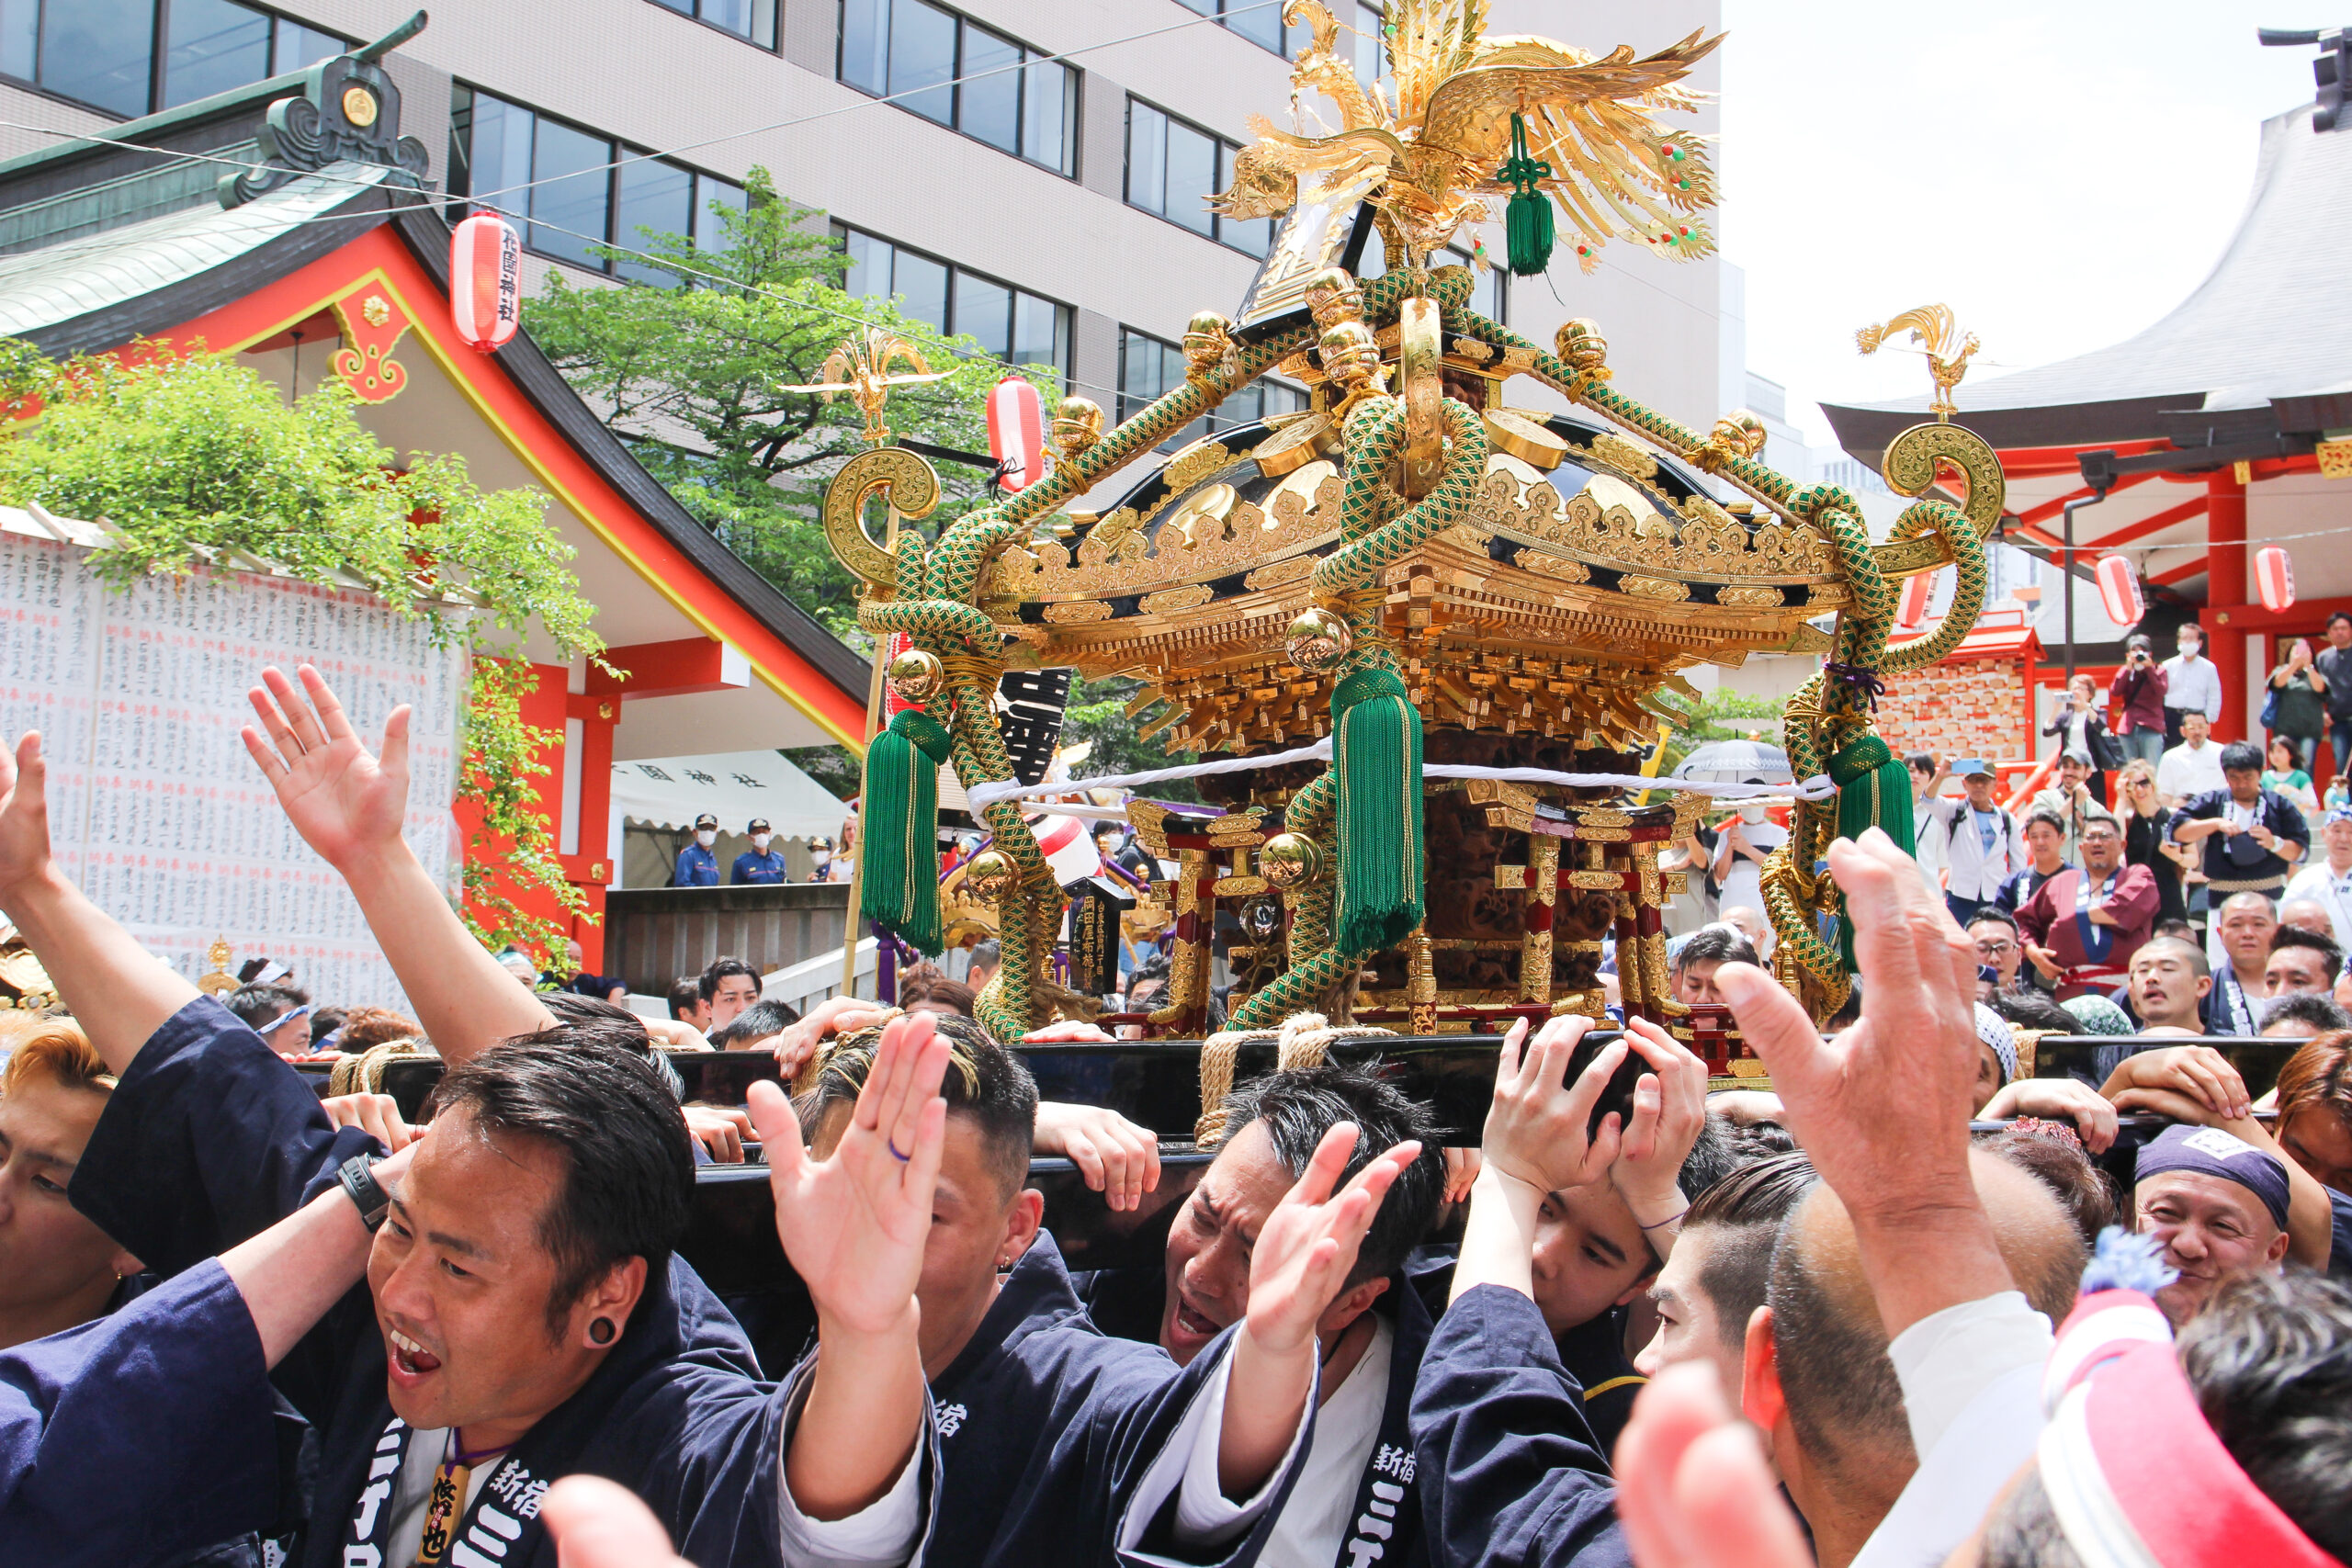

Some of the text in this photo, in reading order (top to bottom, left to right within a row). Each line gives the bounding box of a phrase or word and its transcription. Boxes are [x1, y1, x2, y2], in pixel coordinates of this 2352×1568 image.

[611, 763, 768, 788] 園神社
[1373, 1443, 1418, 1484] 新宿
[489, 1459, 551, 1520] 新宿
